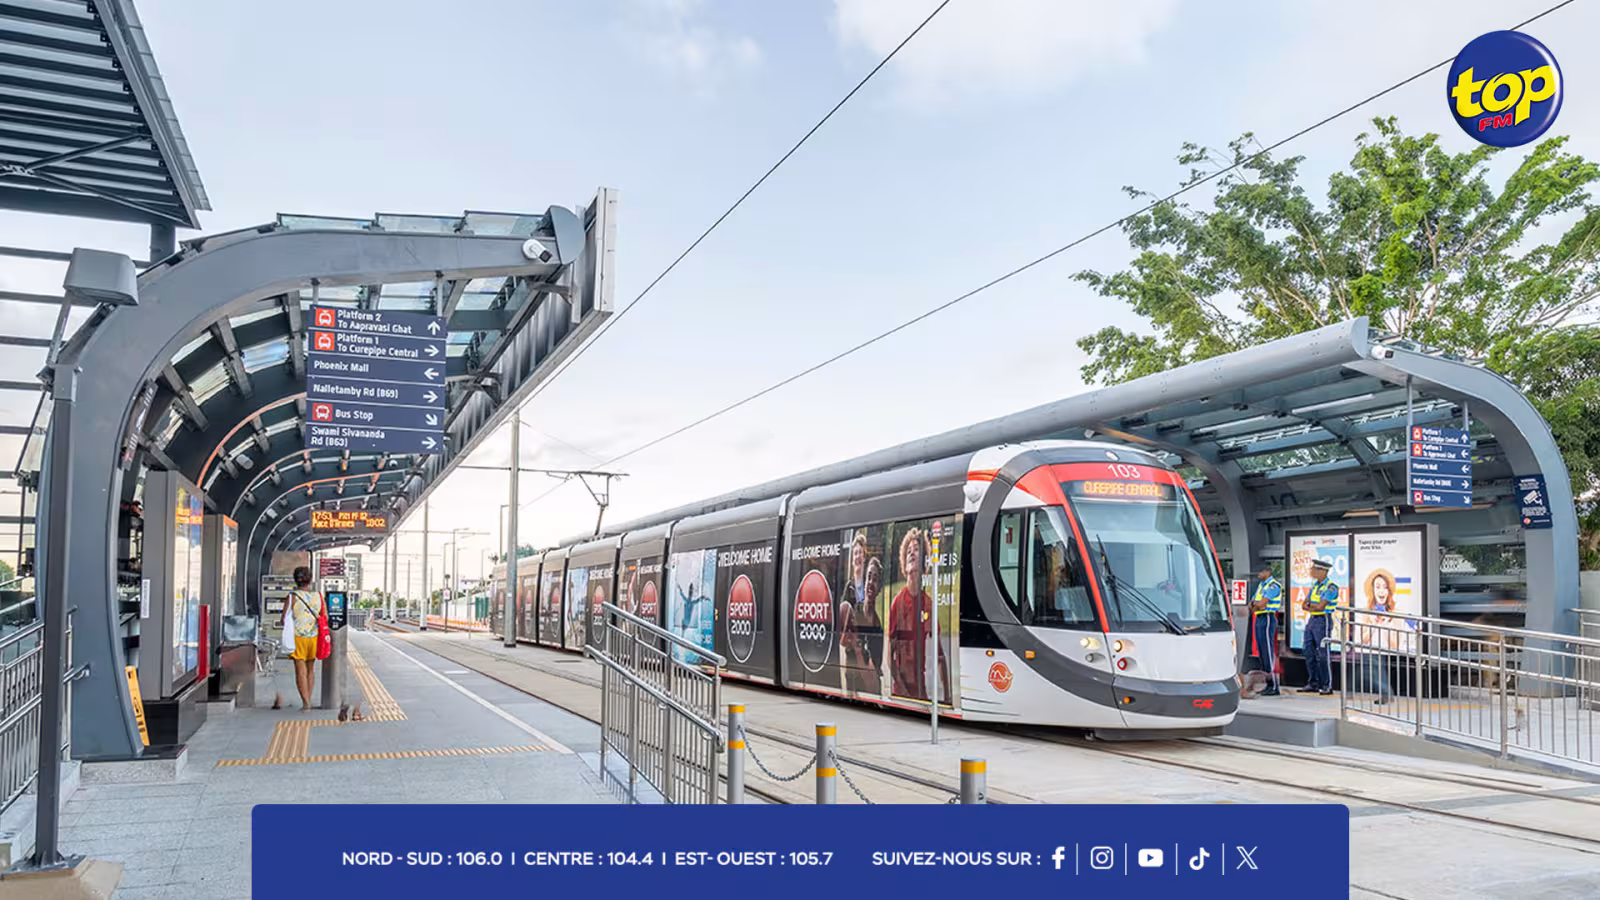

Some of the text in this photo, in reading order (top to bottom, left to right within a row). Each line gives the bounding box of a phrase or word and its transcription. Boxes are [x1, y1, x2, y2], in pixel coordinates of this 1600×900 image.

[337, 309, 382, 322] Platform 2
[337, 319, 412, 334] To Aapravasi Ghat
[337, 333, 379, 345] Platform 1
[337, 343, 419, 357] To Curepipe Central
[313, 360, 370, 373] Phoenix Mall
[313, 384, 362, 398] Nalletamby
[363, 387, 375, 397] Rd
[335, 409, 374, 422] Bus Stop
[311, 426, 385, 439] Swami Sivananda
[311, 436, 323, 446] Rd
[1107, 464, 1141, 479] 103
[1083, 481, 1163, 497] CUREPIPE CENTRAL
[718, 546, 773, 568] WELCOME HOME
[792, 543, 841, 560] WELCOME HOME
[729, 603, 753, 617] SPORT
[797, 603, 829, 620] SPORT
[731, 620, 751, 635] 2000
[799, 623, 826, 640] 2000
